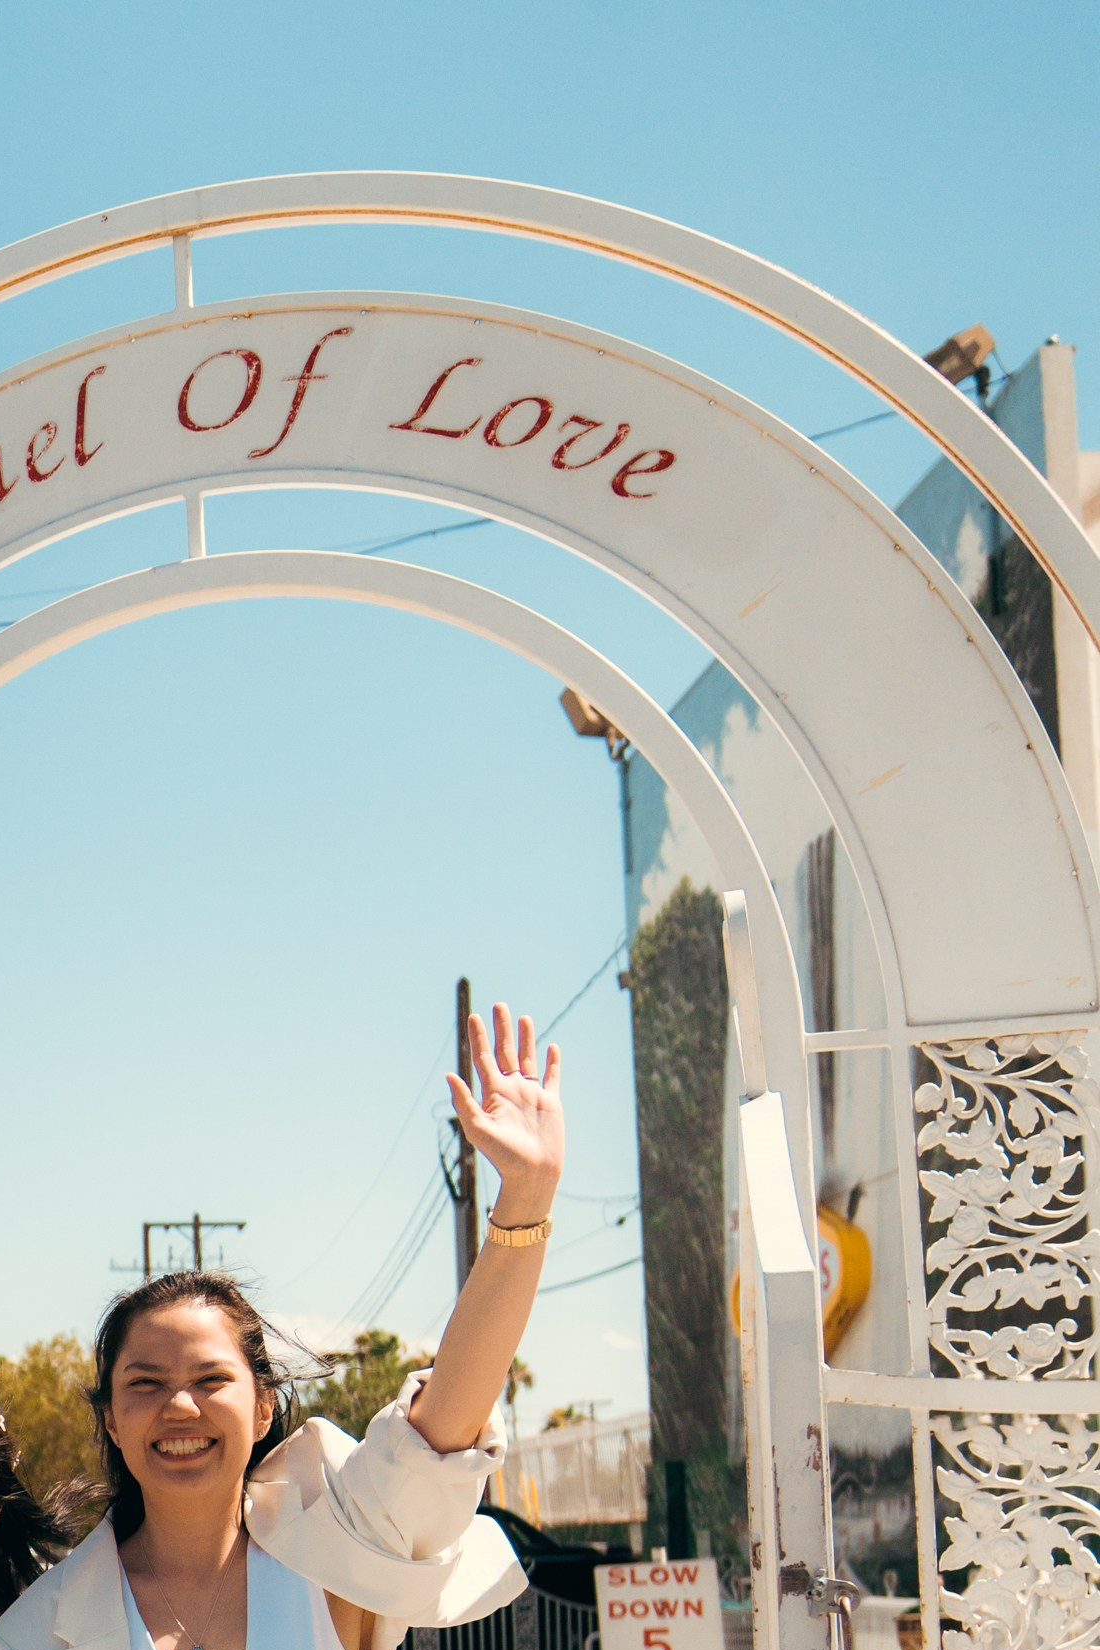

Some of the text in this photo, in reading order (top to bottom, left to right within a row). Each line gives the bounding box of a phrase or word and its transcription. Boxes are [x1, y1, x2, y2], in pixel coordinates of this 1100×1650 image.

[176, 325, 354, 460] Of
[388, 356, 678, 501] Love
[607, 1564, 701, 1588] SLOW
[607, 1597, 705, 1621] DOWN
